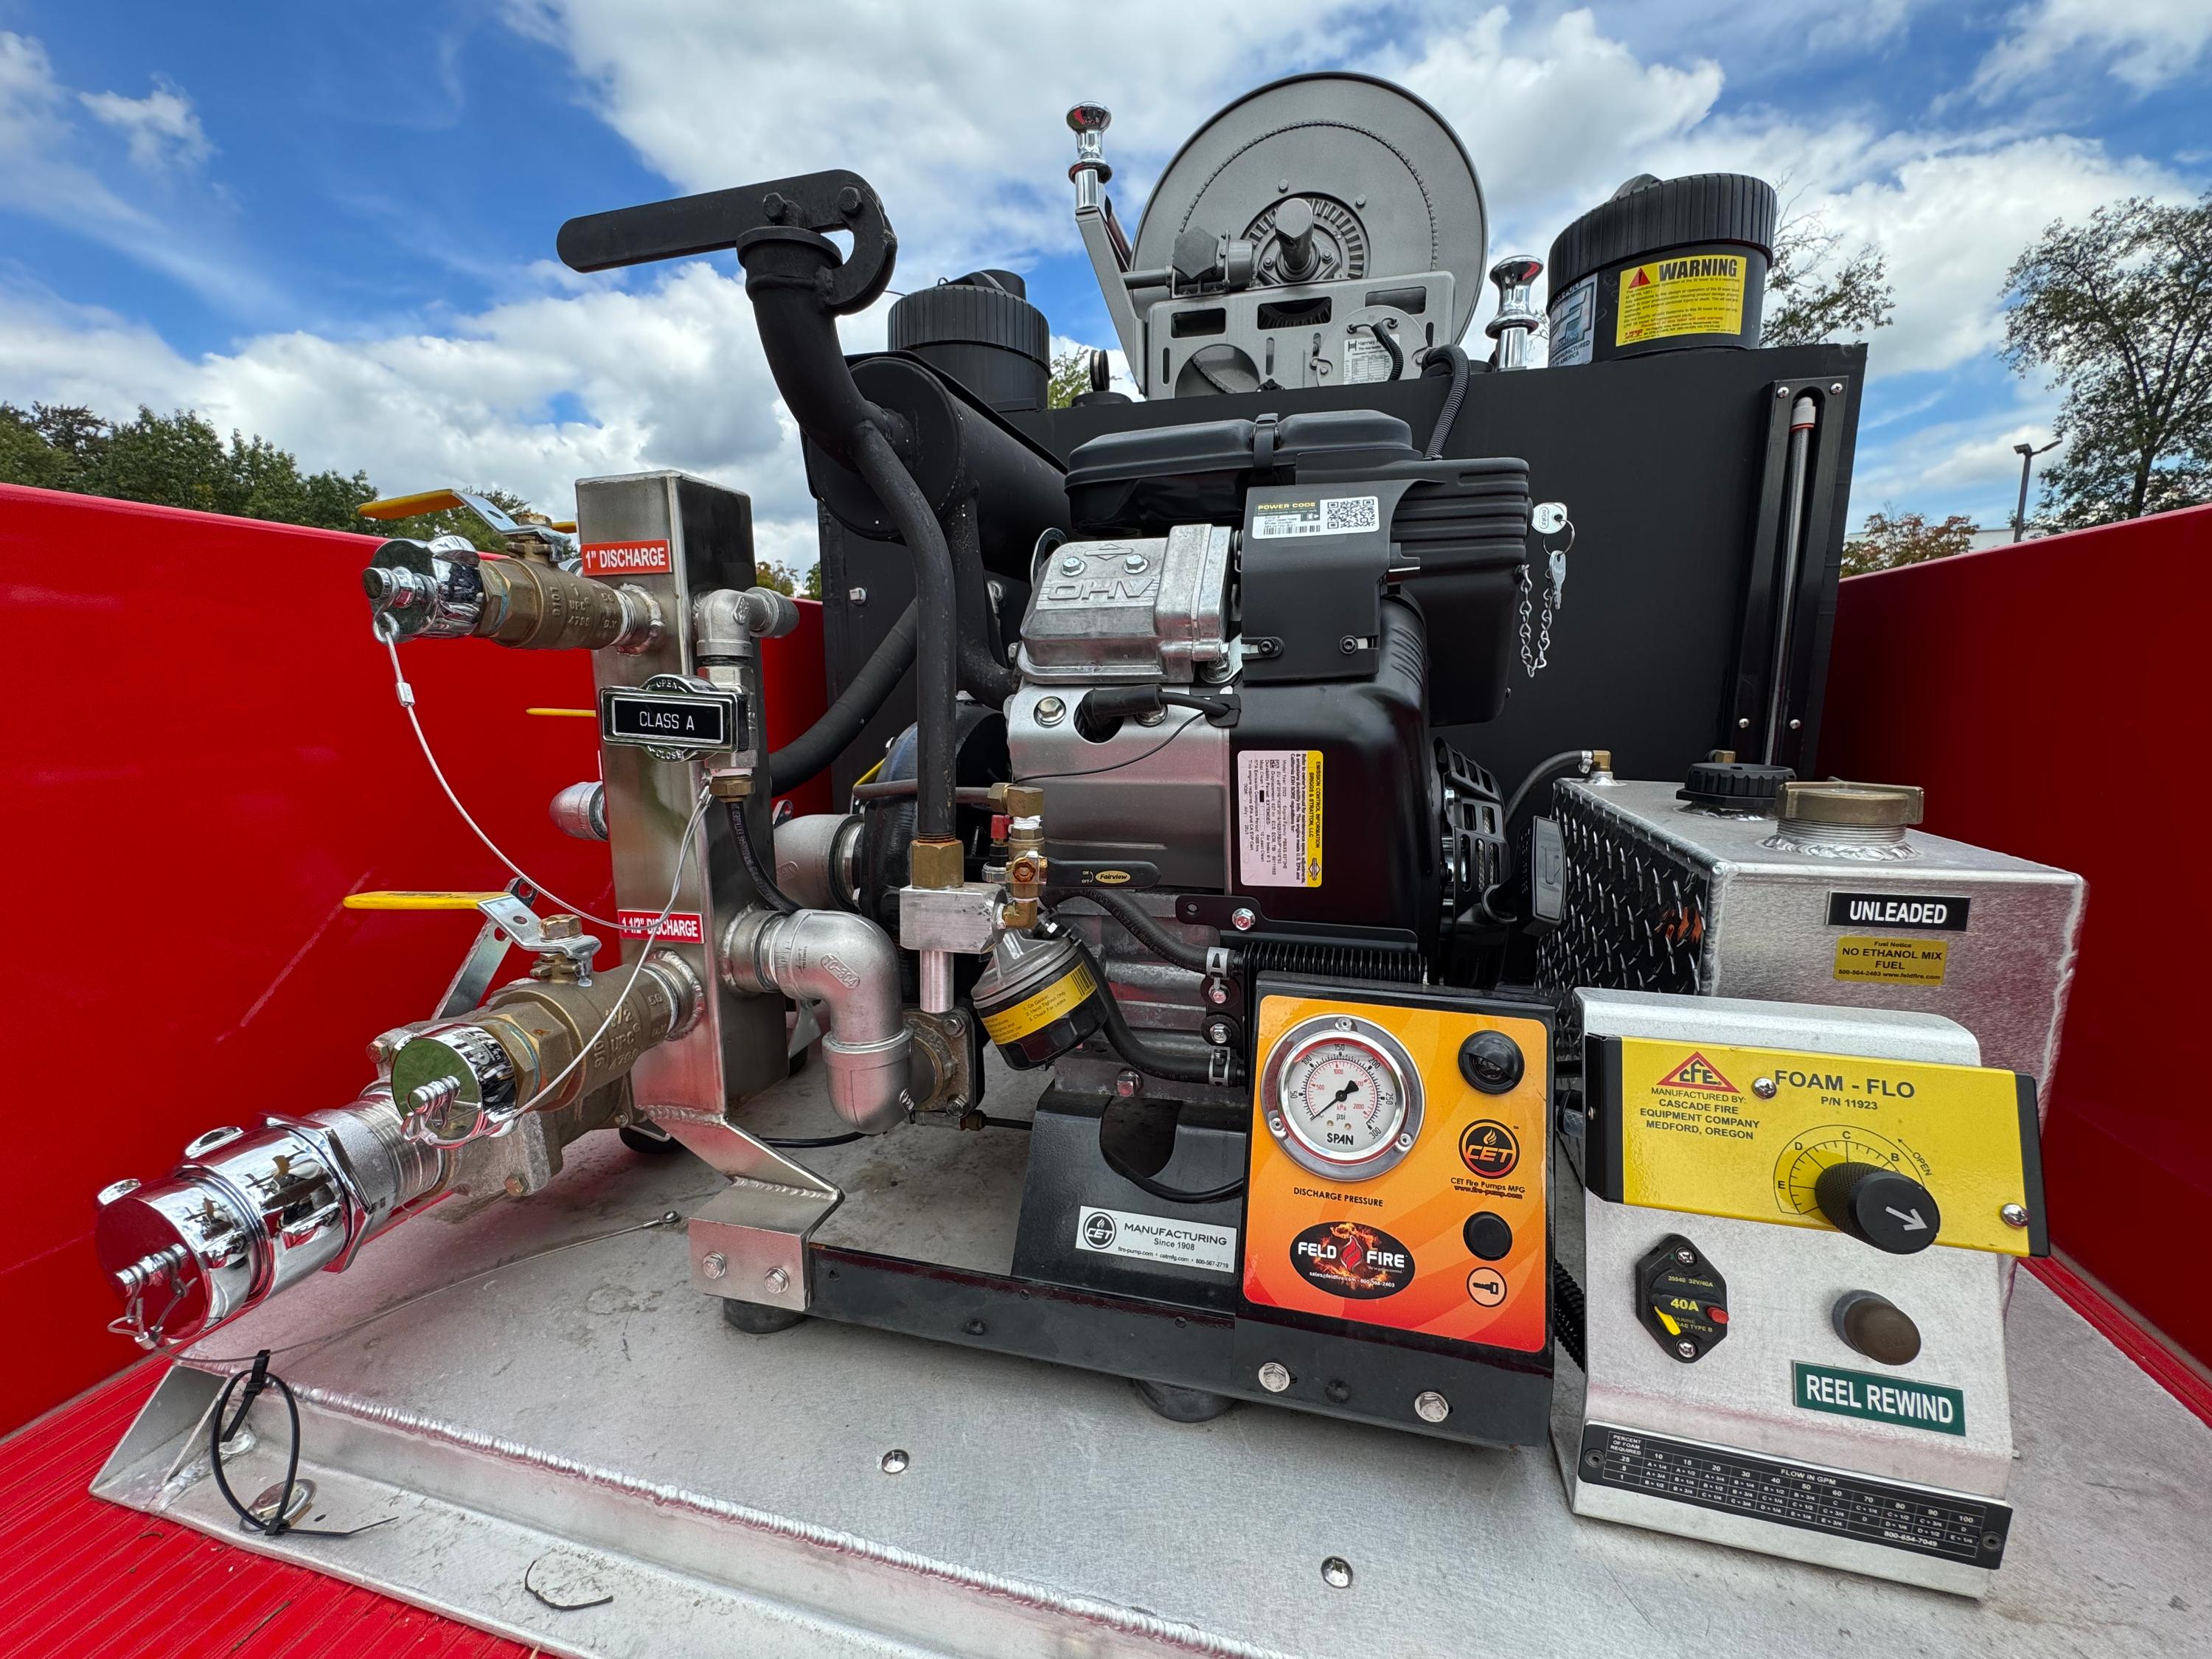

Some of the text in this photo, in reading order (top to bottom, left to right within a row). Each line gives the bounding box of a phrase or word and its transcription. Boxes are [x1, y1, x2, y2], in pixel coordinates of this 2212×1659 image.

[1659, 259, 1737, 282] WARNING
[599, 547, 665, 568] DISCHARGE
[1048, 579, 1154, 600] OHV
[569, 600, 586, 611] UPC
[655, 680, 678, 689] OPEN
[639, 711, 695, 730] CLASS A
[655, 749, 685, 759] CLOSE
[1850, 900, 1947, 924] UNLEADED
[622, 917, 627, 933] 1
[647, 918, 698, 937] DISCHARGE
[1843, 947, 1942, 960] NO ETHANOL MIX
[1875, 961, 1905, 970] FUEL
[1882, 972, 1941, 980] www.feldfire.com
[1301, 1055, 1312, 1065] 100
[1368, 1057, 1381, 1068] 200
[1775, 1070, 1843, 1091] FOAM
[1866, 1078, 1915, 1098] FLO
[1290, 1091, 1298, 1099] 50
[1651, 1087, 1746, 1104] MANUFACTURED BY:
[1659, 1099, 1739, 1114] CASCADE FIRE
[1821, 1096, 1878, 1110] P/N 11923
[1640, 1107, 1759, 1128] EQUIPMENT COMPANY
[1368, 1127, 1381, 1139] 300
[1646, 1120, 1753, 1140] MEDFORD, OREGON
[1842, 1131, 1851, 1139] C
[1327, 1133, 1354, 1145] SPAN
[1795, 1142, 1803, 1150] D
[1467, 1144, 1514, 1163] CET
[1891, 1152, 1900, 1161] B
[1912, 1152, 1933, 1177] OPEN
[1481, 1181, 1506, 1190] Pumps
[1508, 1185, 1525, 1193] MFG
[1778, 1180, 1786, 1189] E
[1293, 1187, 1383, 1207] DISCHARGE PRESSURE
[1454, 1186, 1523, 1199] www.fire-pump.com
[1088, 1228, 1113, 1240] CET
[1124, 1222, 1227, 1246] MANUFACTURING
[1154, 1238, 1195, 1251] Since 1908
[1118, 1246, 1228, 1269] fire-pump.com cetmfg.com 800-567-2719
[1298, 1242, 1405, 1268] FELD FIRE
[1688, 1279, 1714, 1287] 32V/40A
[1671, 1298, 1699, 1312] 40A
[1677, 1321, 1689, 1329] SAE
[1806, 1374, 1953, 1424] REEL REWIND
[1613, 1434, 1642, 1444] PERCENT
[1622, 1441, 1641, 1450] FOAM
[1610, 1444, 1641, 1455] REQUIRED
[1781, 1469, 1805, 1478] FLOW
[1817, 1476, 1836, 1485] GPM
[1958, 1515, 1974, 1523] 100
